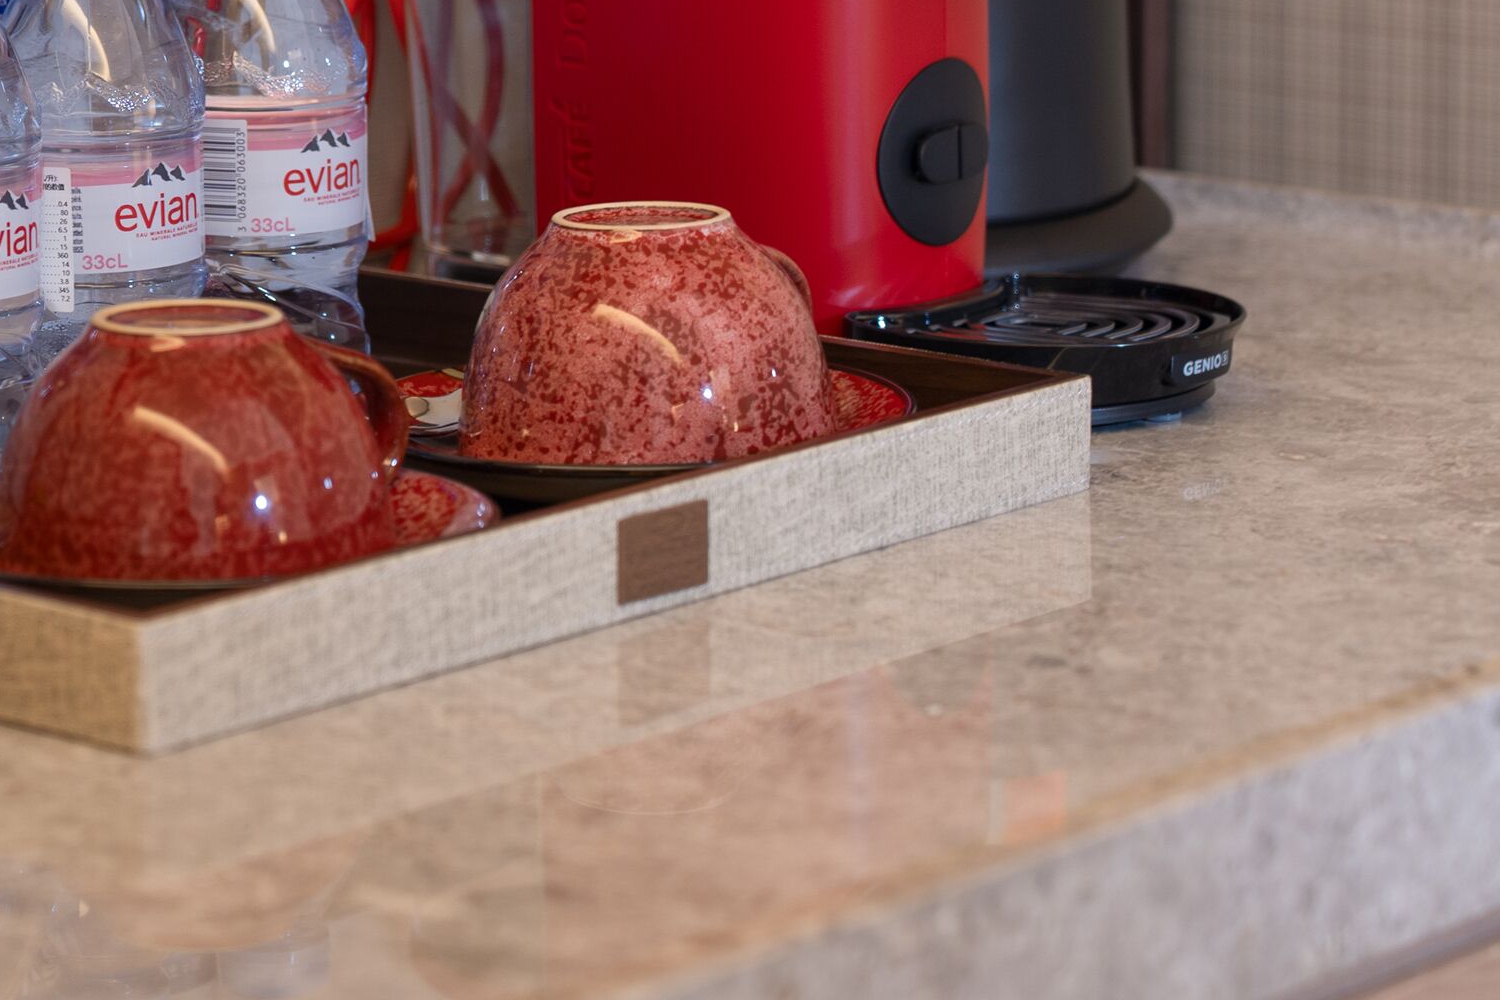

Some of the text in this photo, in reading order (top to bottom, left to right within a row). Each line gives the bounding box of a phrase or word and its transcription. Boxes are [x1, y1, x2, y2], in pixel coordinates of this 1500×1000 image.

[236, 131, 246, 172] 063003
[284, 158, 360, 196] evian
[114, 192, 197, 232] evian
[237, 177, 247, 219] 068320
[251, 217, 295, 233] 33cL
[82, 254, 128, 270] 33cL
[1183, 353, 1221, 376] GENIO
